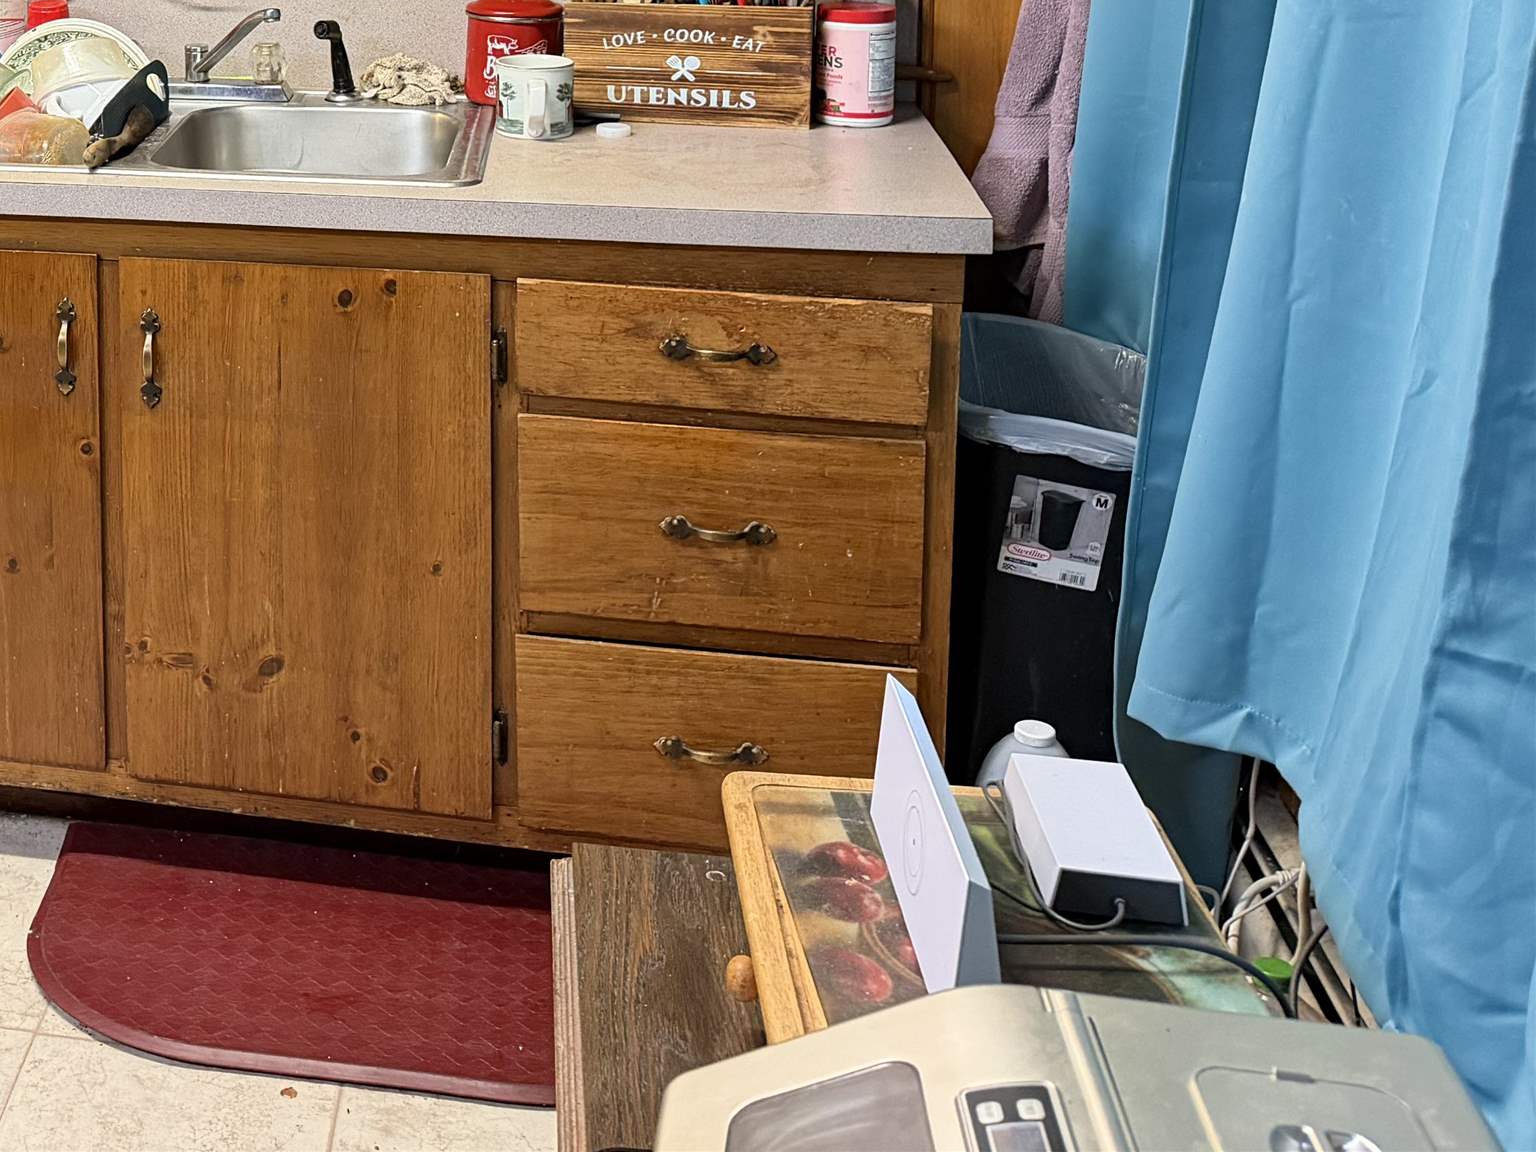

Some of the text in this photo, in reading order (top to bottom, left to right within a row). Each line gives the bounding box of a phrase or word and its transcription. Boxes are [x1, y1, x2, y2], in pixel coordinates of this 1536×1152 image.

[602, 28, 767, 54] LOVE COOK EAT
[605, 84, 758, 110] UTENSILS
[1095, 497, 1110, 509] M
[1011, 544, 1049, 560] Sterilite
